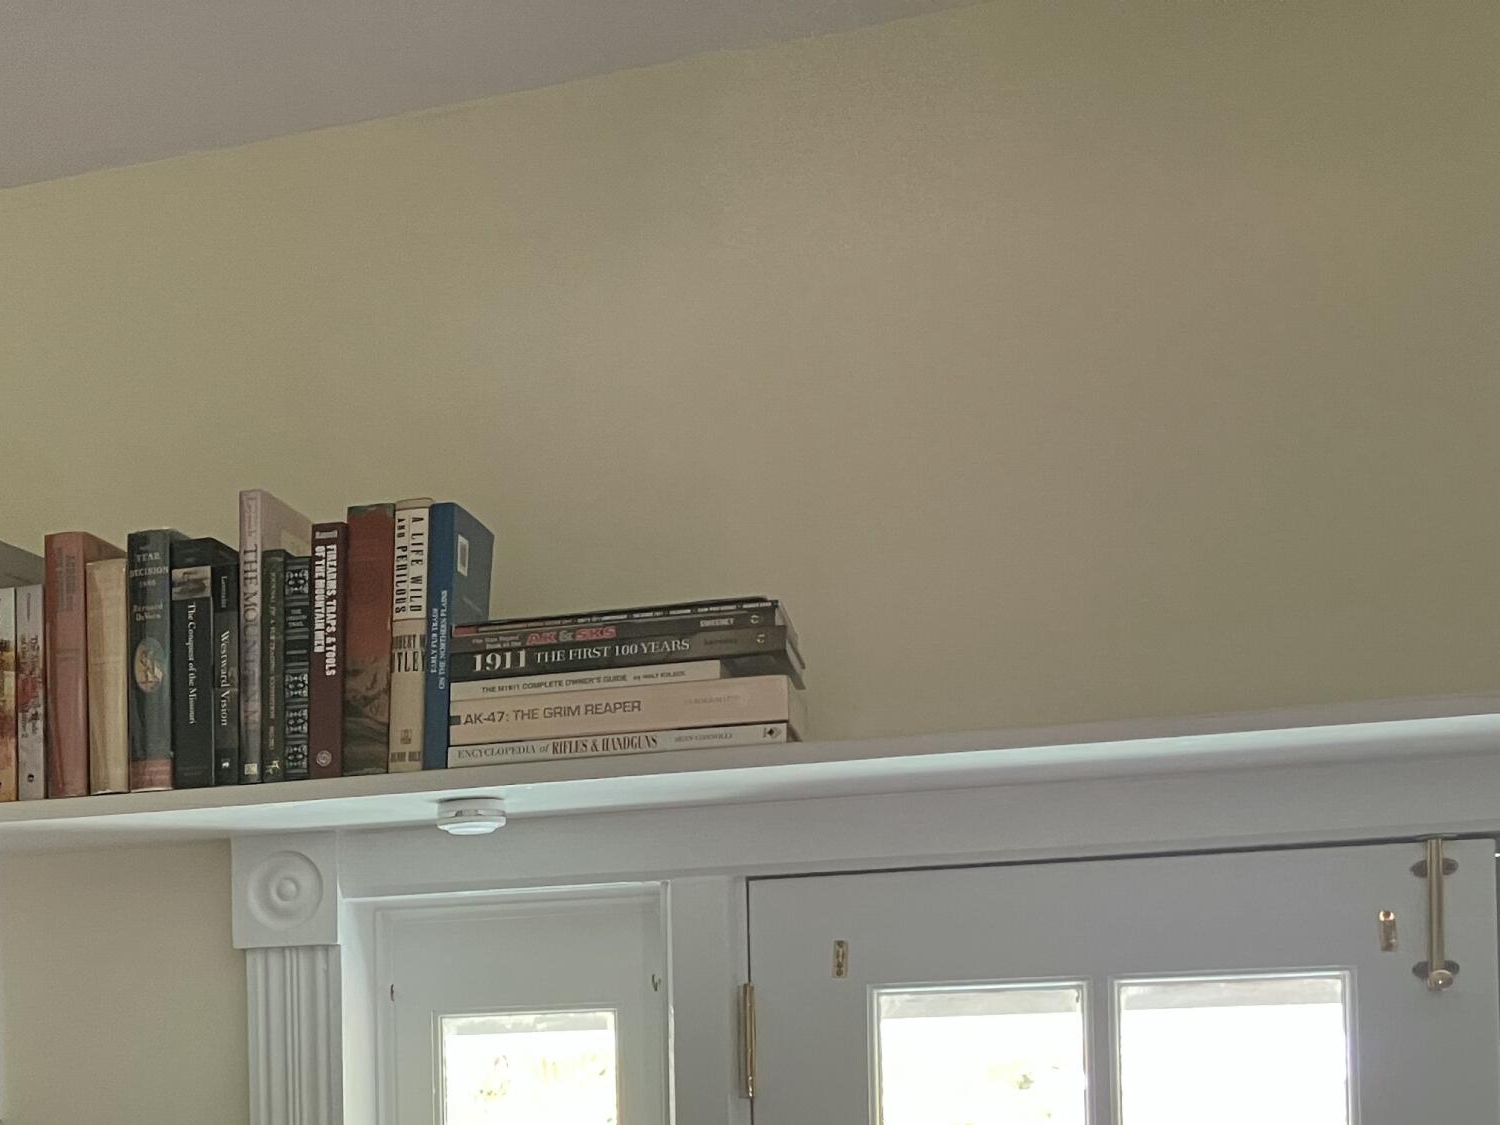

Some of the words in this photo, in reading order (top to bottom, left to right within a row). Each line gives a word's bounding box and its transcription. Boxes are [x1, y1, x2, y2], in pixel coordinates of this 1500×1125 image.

[396, 518, 406, 538] AND
[410, 516, 424, 524] A
[136, 552, 161, 563] YEAR
[314, 544, 326, 558] OF
[410, 532, 424, 568] LIFE
[242, 542, 258, 588] THE
[314, 558, 326, 580] THE
[394, 546, 408, 614] PERILOUS
[314, 578, 326, 630] MOUNTAIN
[410, 576, 424, 614] WILD
[186, 602, 196, 620] The
[324, 598, 338, 636] TRAPS,
[184, 622, 196, 662] Conquest
[324, 636, 338, 644] &
[438, 618, 448, 660] NORTHERN
[525, 631, 558, 646] AK
[558, 630, 573, 642] &
[574, 625, 617, 641] SKS
[186, 662, 196, 672] of
[220, 630, 232, 688] Westward
[324, 646, 338, 678] TOOLS
[472, 649, 526, 672] 1911
[535, 651, 566, 664] THE
[569, 645, 611, 660] FIRST
[614, 645, 638, 657] 100
[640, 638, 690, 654] YEARS
[186, 672, 196, 686] the
[438, 660, 448, 676] THE
[438, 678, 448, 690] ON
[522, 681, 563, 690] COMPLETE
[186, 688, 196, 724] Missouri
[220, 688, 232, 728] Vision
[462, 711, 510, 725] AK-47:
[513, 709, 539, 721] THE
[543, 705, 580, 718] GRIM
[585, 700, 642, 715] REAPER
[457, 746, 536, 759] ENCYCLOPEDIA
[539, 744, 550, 753] of
[551, 739, 589, 755] RIFLES
[590, 739, 599, 750] &
[601, 734, 658, 751] HANDGUNS
